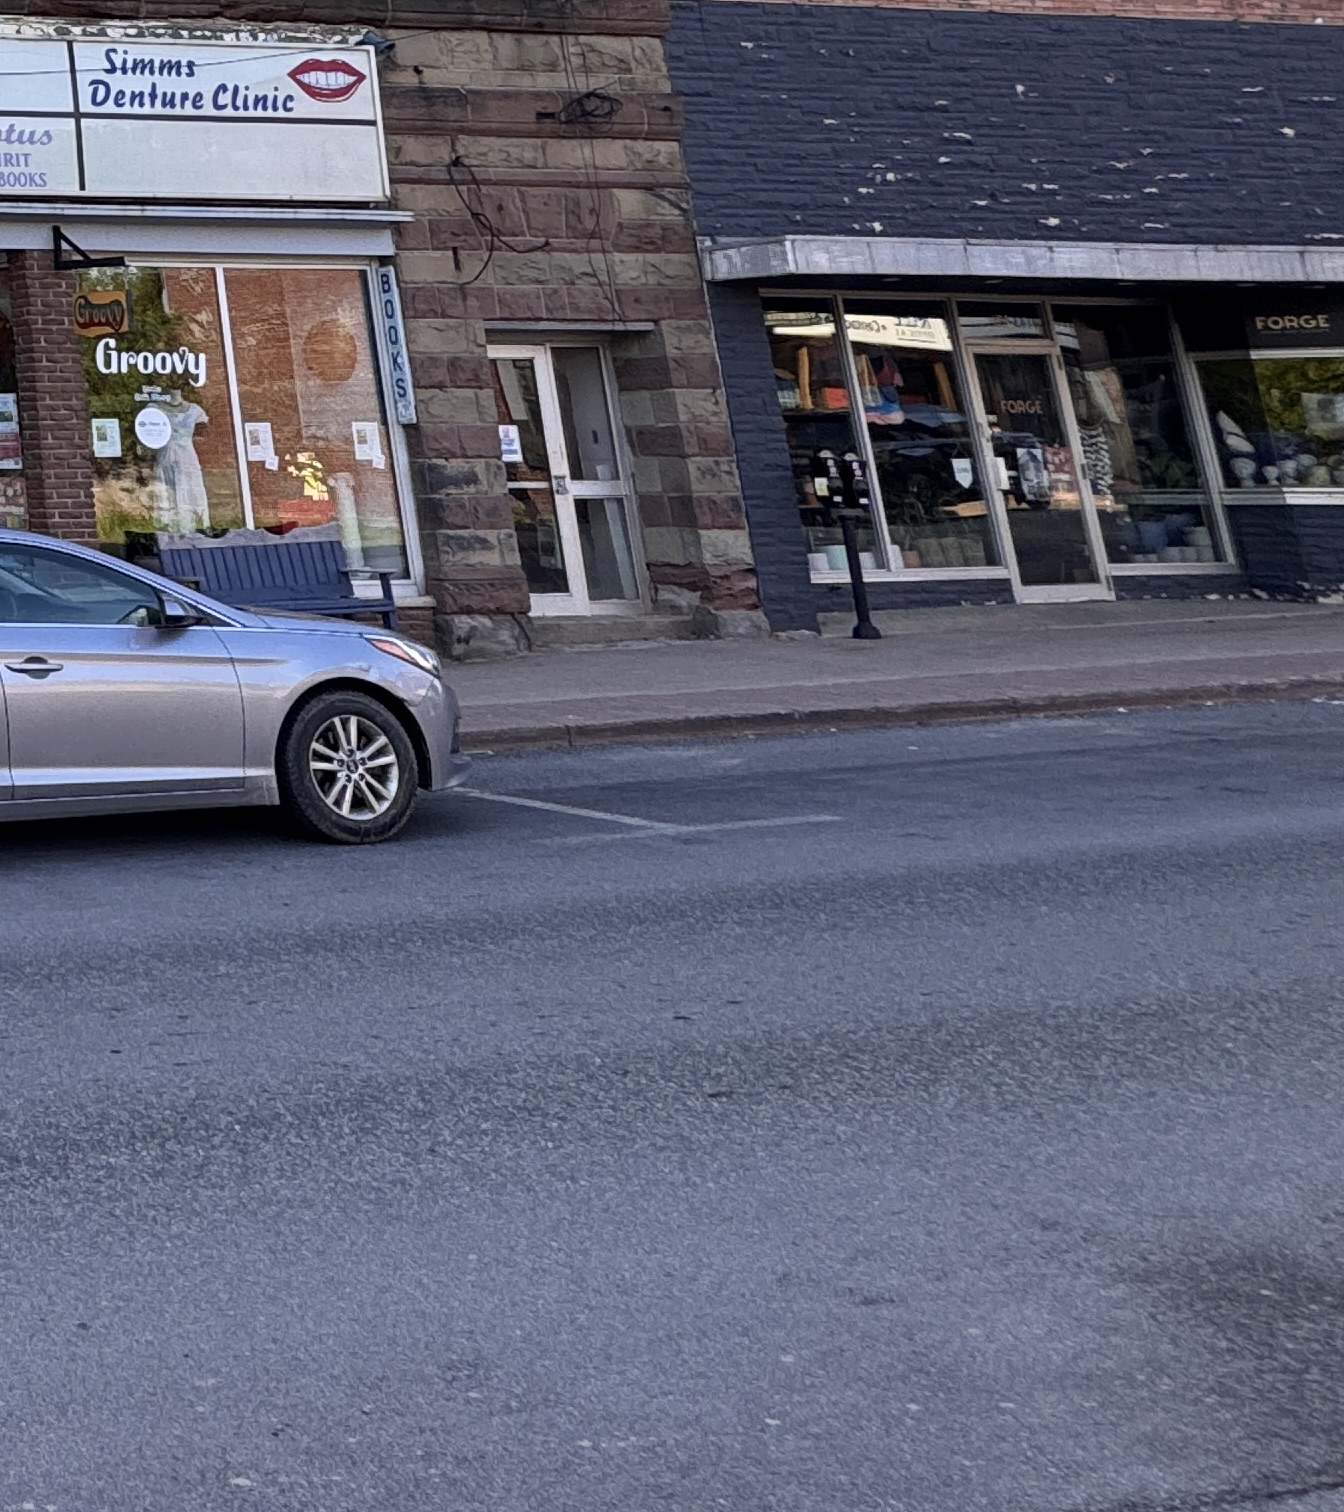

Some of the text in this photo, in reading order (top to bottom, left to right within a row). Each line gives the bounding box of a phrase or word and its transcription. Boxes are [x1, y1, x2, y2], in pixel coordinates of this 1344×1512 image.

[102, 47, 197, 78] Simms
[88, 79, 296, 113] Denture Clinic
[74, 295, 125, 332] Groovy
[1254, 314, 1331, 330] FORGE
[380, 272, 408, 399] BOOKS
[95, 337, 207, 388] Groovy
[1000, 399, 1043, 414] FORGE
